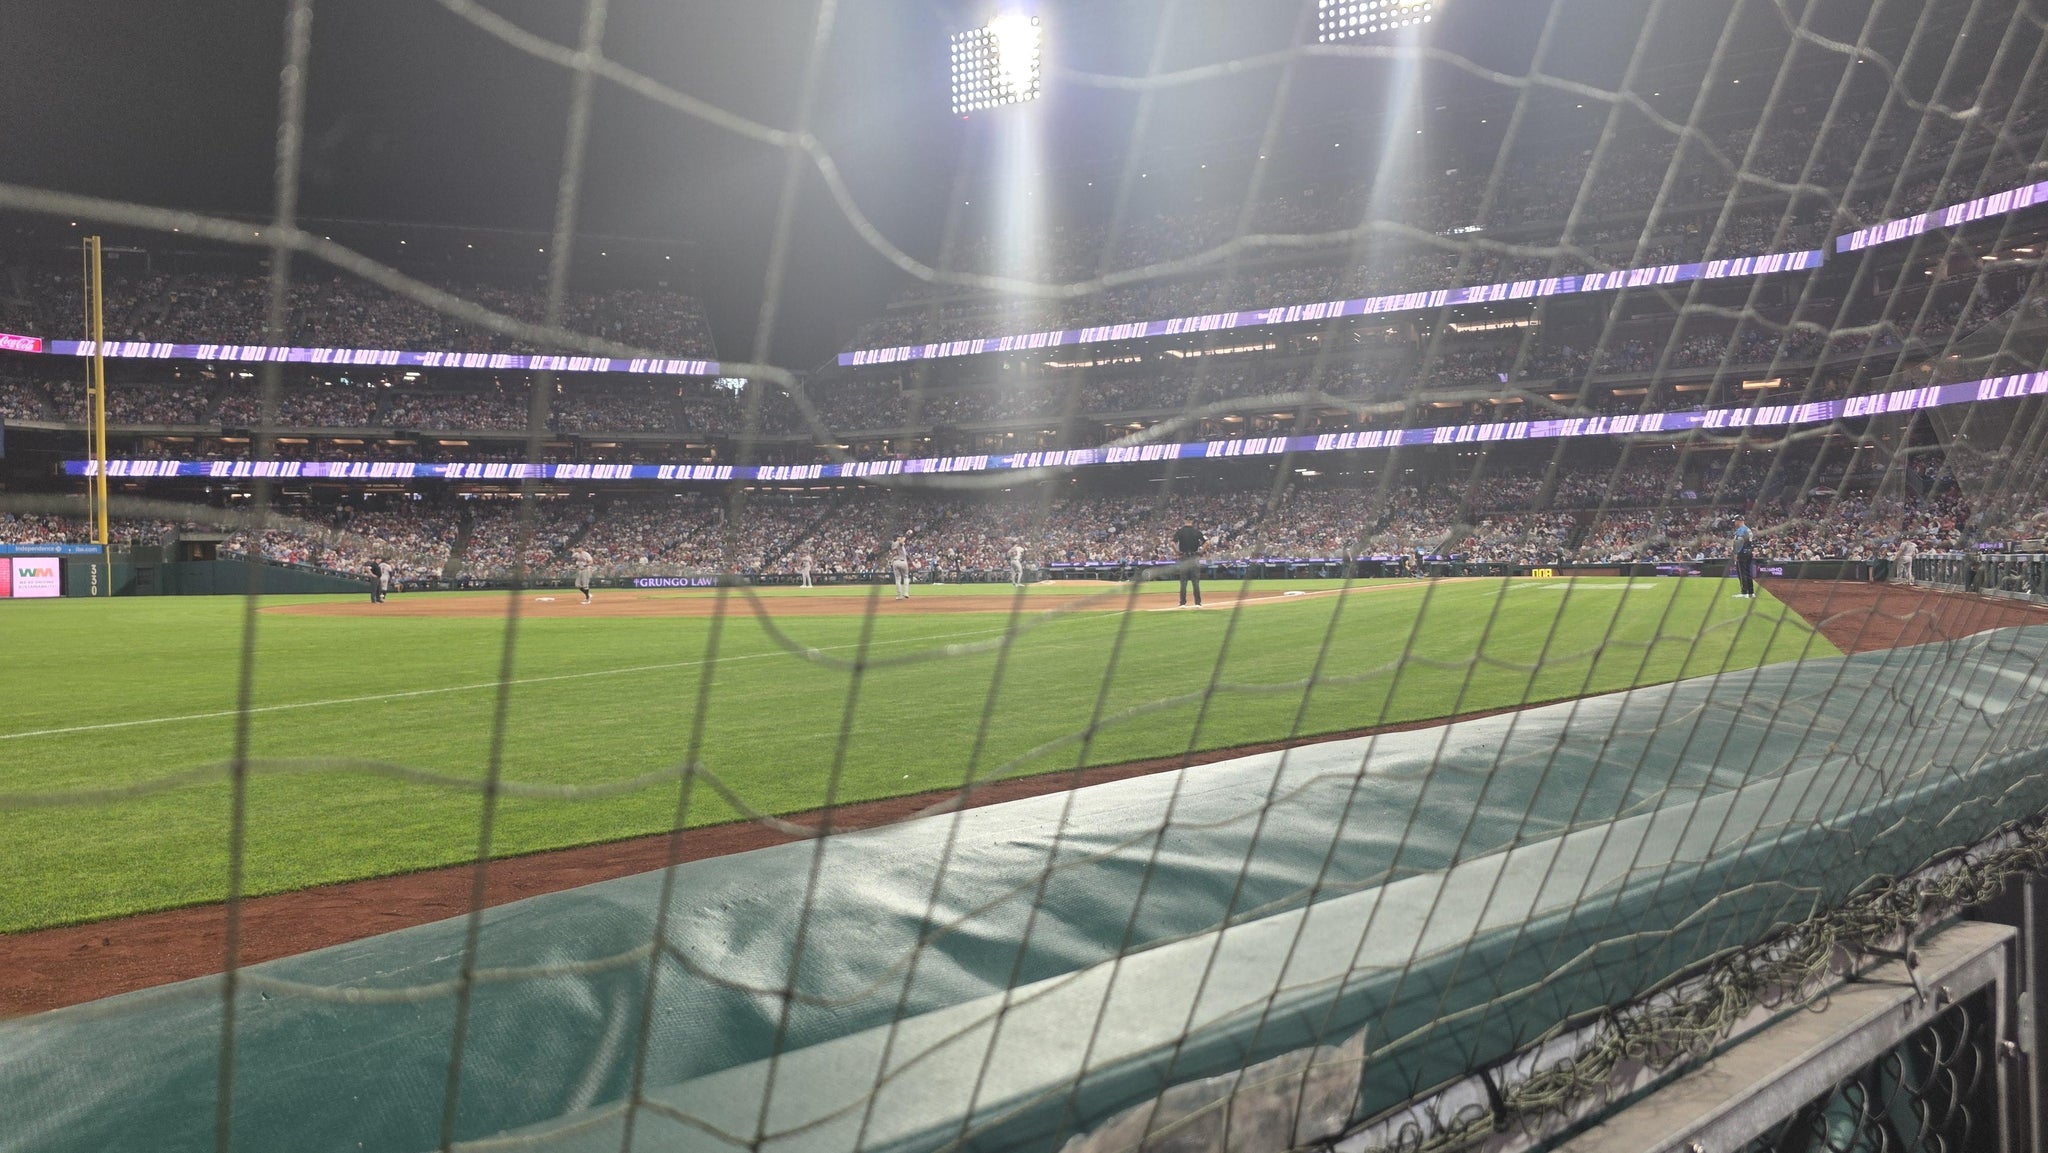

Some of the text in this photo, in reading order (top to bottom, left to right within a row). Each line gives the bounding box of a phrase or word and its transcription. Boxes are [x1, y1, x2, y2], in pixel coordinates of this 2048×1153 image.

[19, 568, 53, 577] WM
[639, 577, 712, 587] GRUNGO LAW
